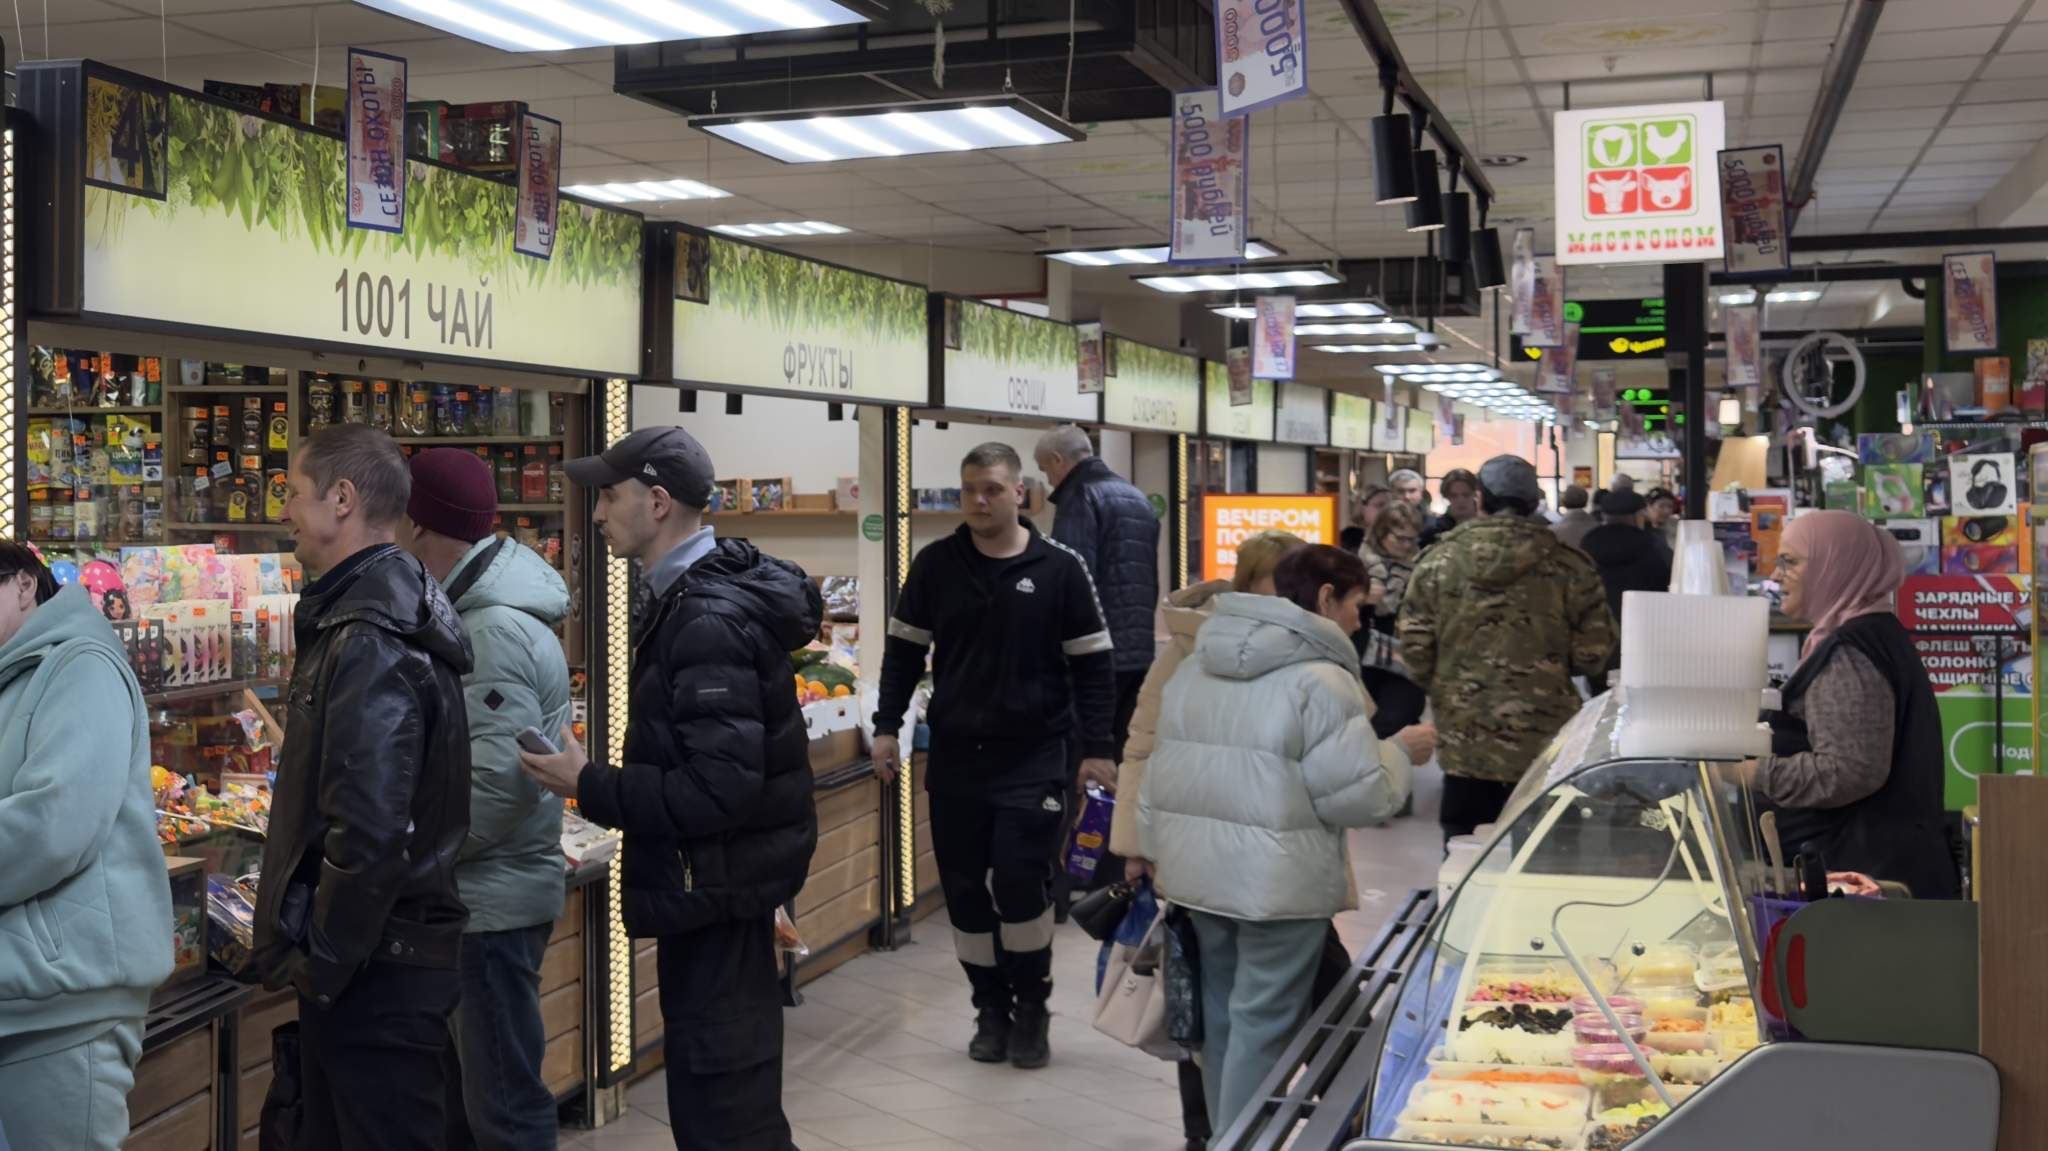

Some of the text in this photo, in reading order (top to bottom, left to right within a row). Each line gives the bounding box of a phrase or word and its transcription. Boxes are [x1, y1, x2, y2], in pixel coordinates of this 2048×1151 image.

[356, 67, 385, 141] ОХОТЫ
[1180, 104, 1212, 157] 5000
[335, 268, 492, 349] 1001 ЧАЙ
[784, 340, 852, 390] ФРУКТЫ
[1216, 508, 1320, 527] ВЕЧЕРОМ
[1915, 592, 2014, 605] ЗАРЯДНЫЕ
[1915, 608, 1979, 620] ЧЕХЛЫ
[1915, 640, 1970, 652] ФЛЕШ
